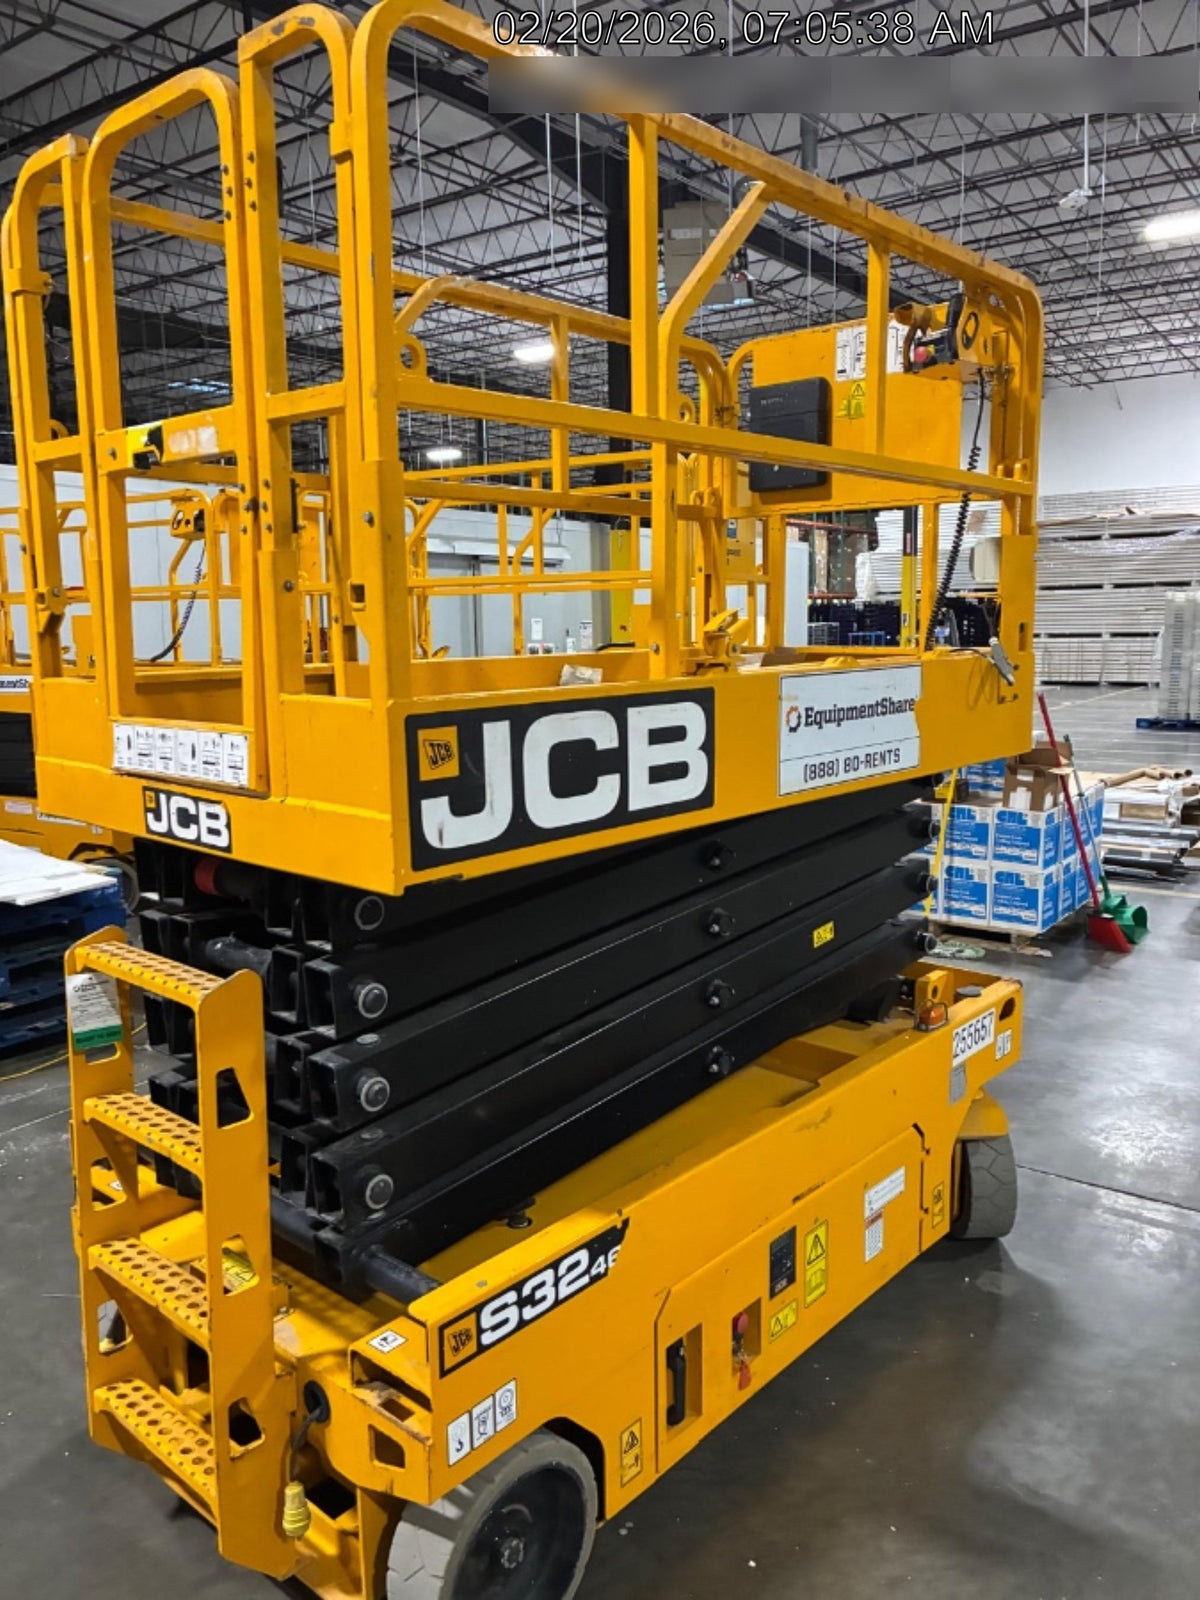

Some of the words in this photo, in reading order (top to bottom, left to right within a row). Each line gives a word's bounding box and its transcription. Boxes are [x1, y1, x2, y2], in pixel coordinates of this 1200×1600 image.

[804, 697, 915, 730] EquipmentShare
[420, 701, 709, 850] JCB
[803, 758, 840, 783] (888)
[146, 792, 230, 848] JCB
[953, 1010, 994, 1058] 255657
